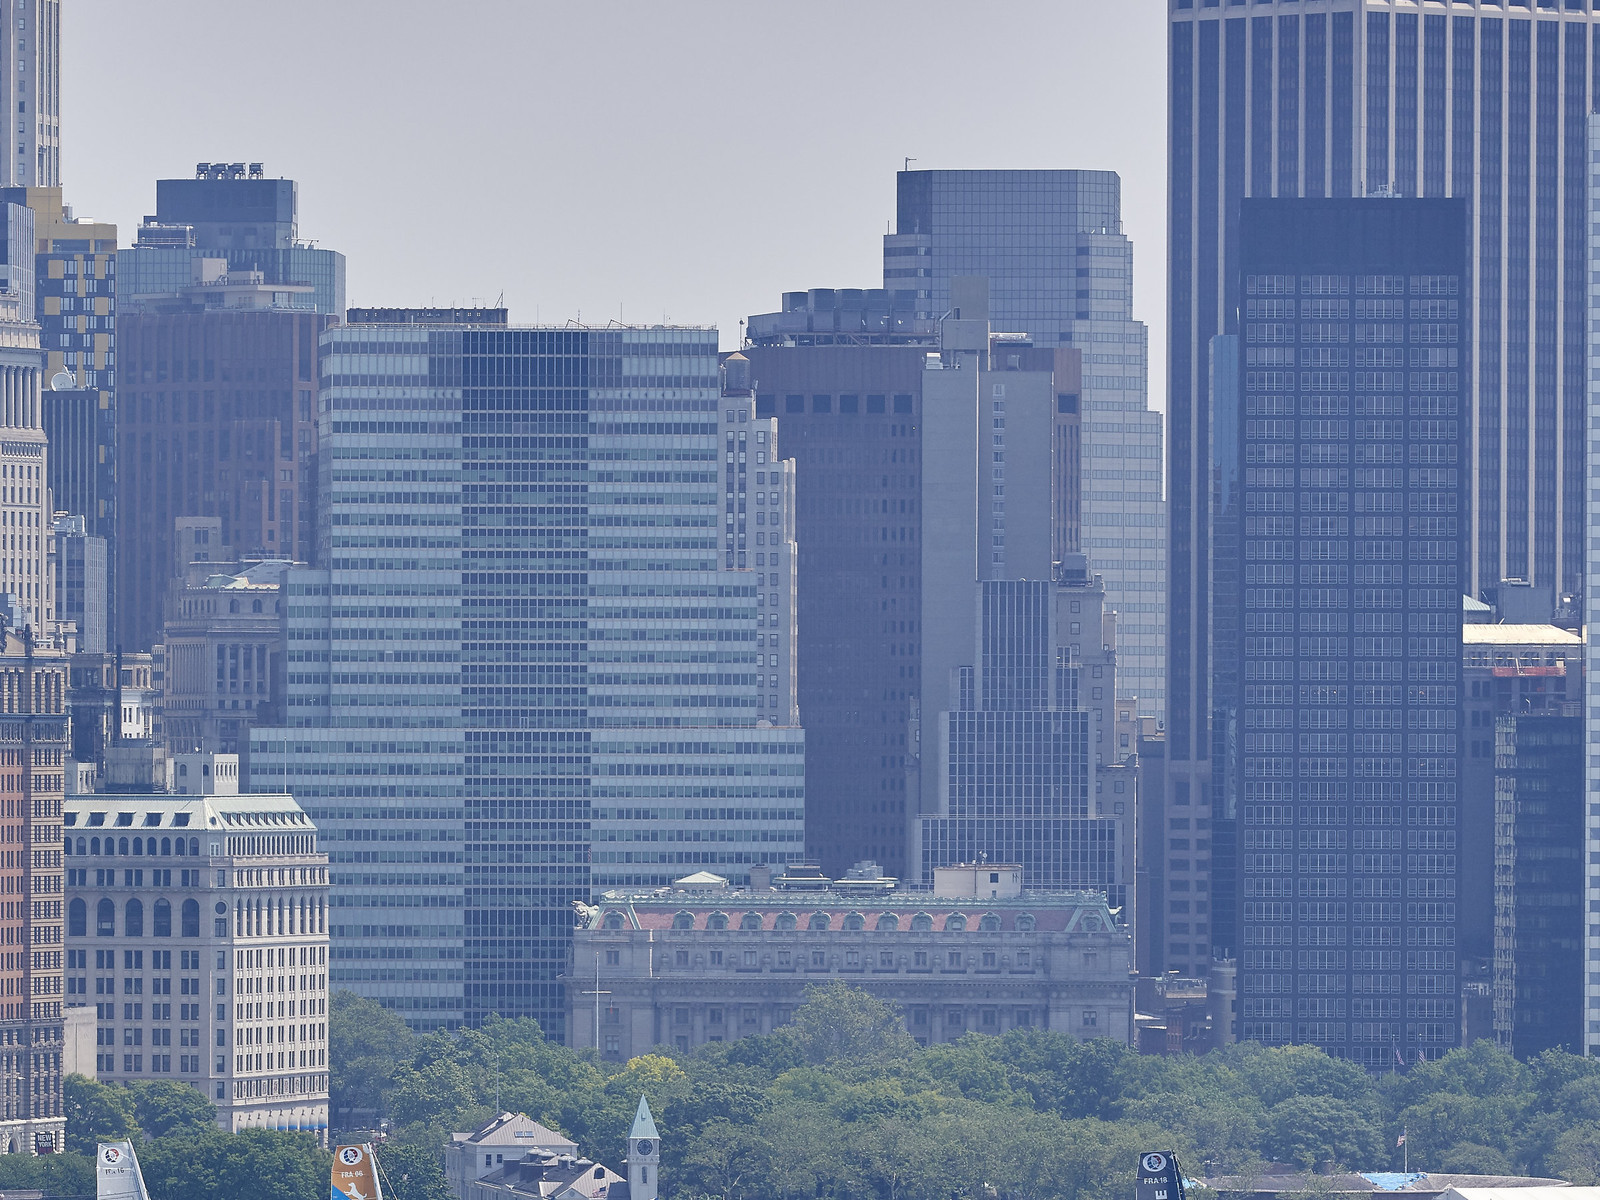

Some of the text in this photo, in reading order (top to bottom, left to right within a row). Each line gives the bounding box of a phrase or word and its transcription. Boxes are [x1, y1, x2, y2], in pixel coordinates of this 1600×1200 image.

[37, 1134, 52, 1142] NEW
[1143, 1176, 1168, 1185] FRA 18
